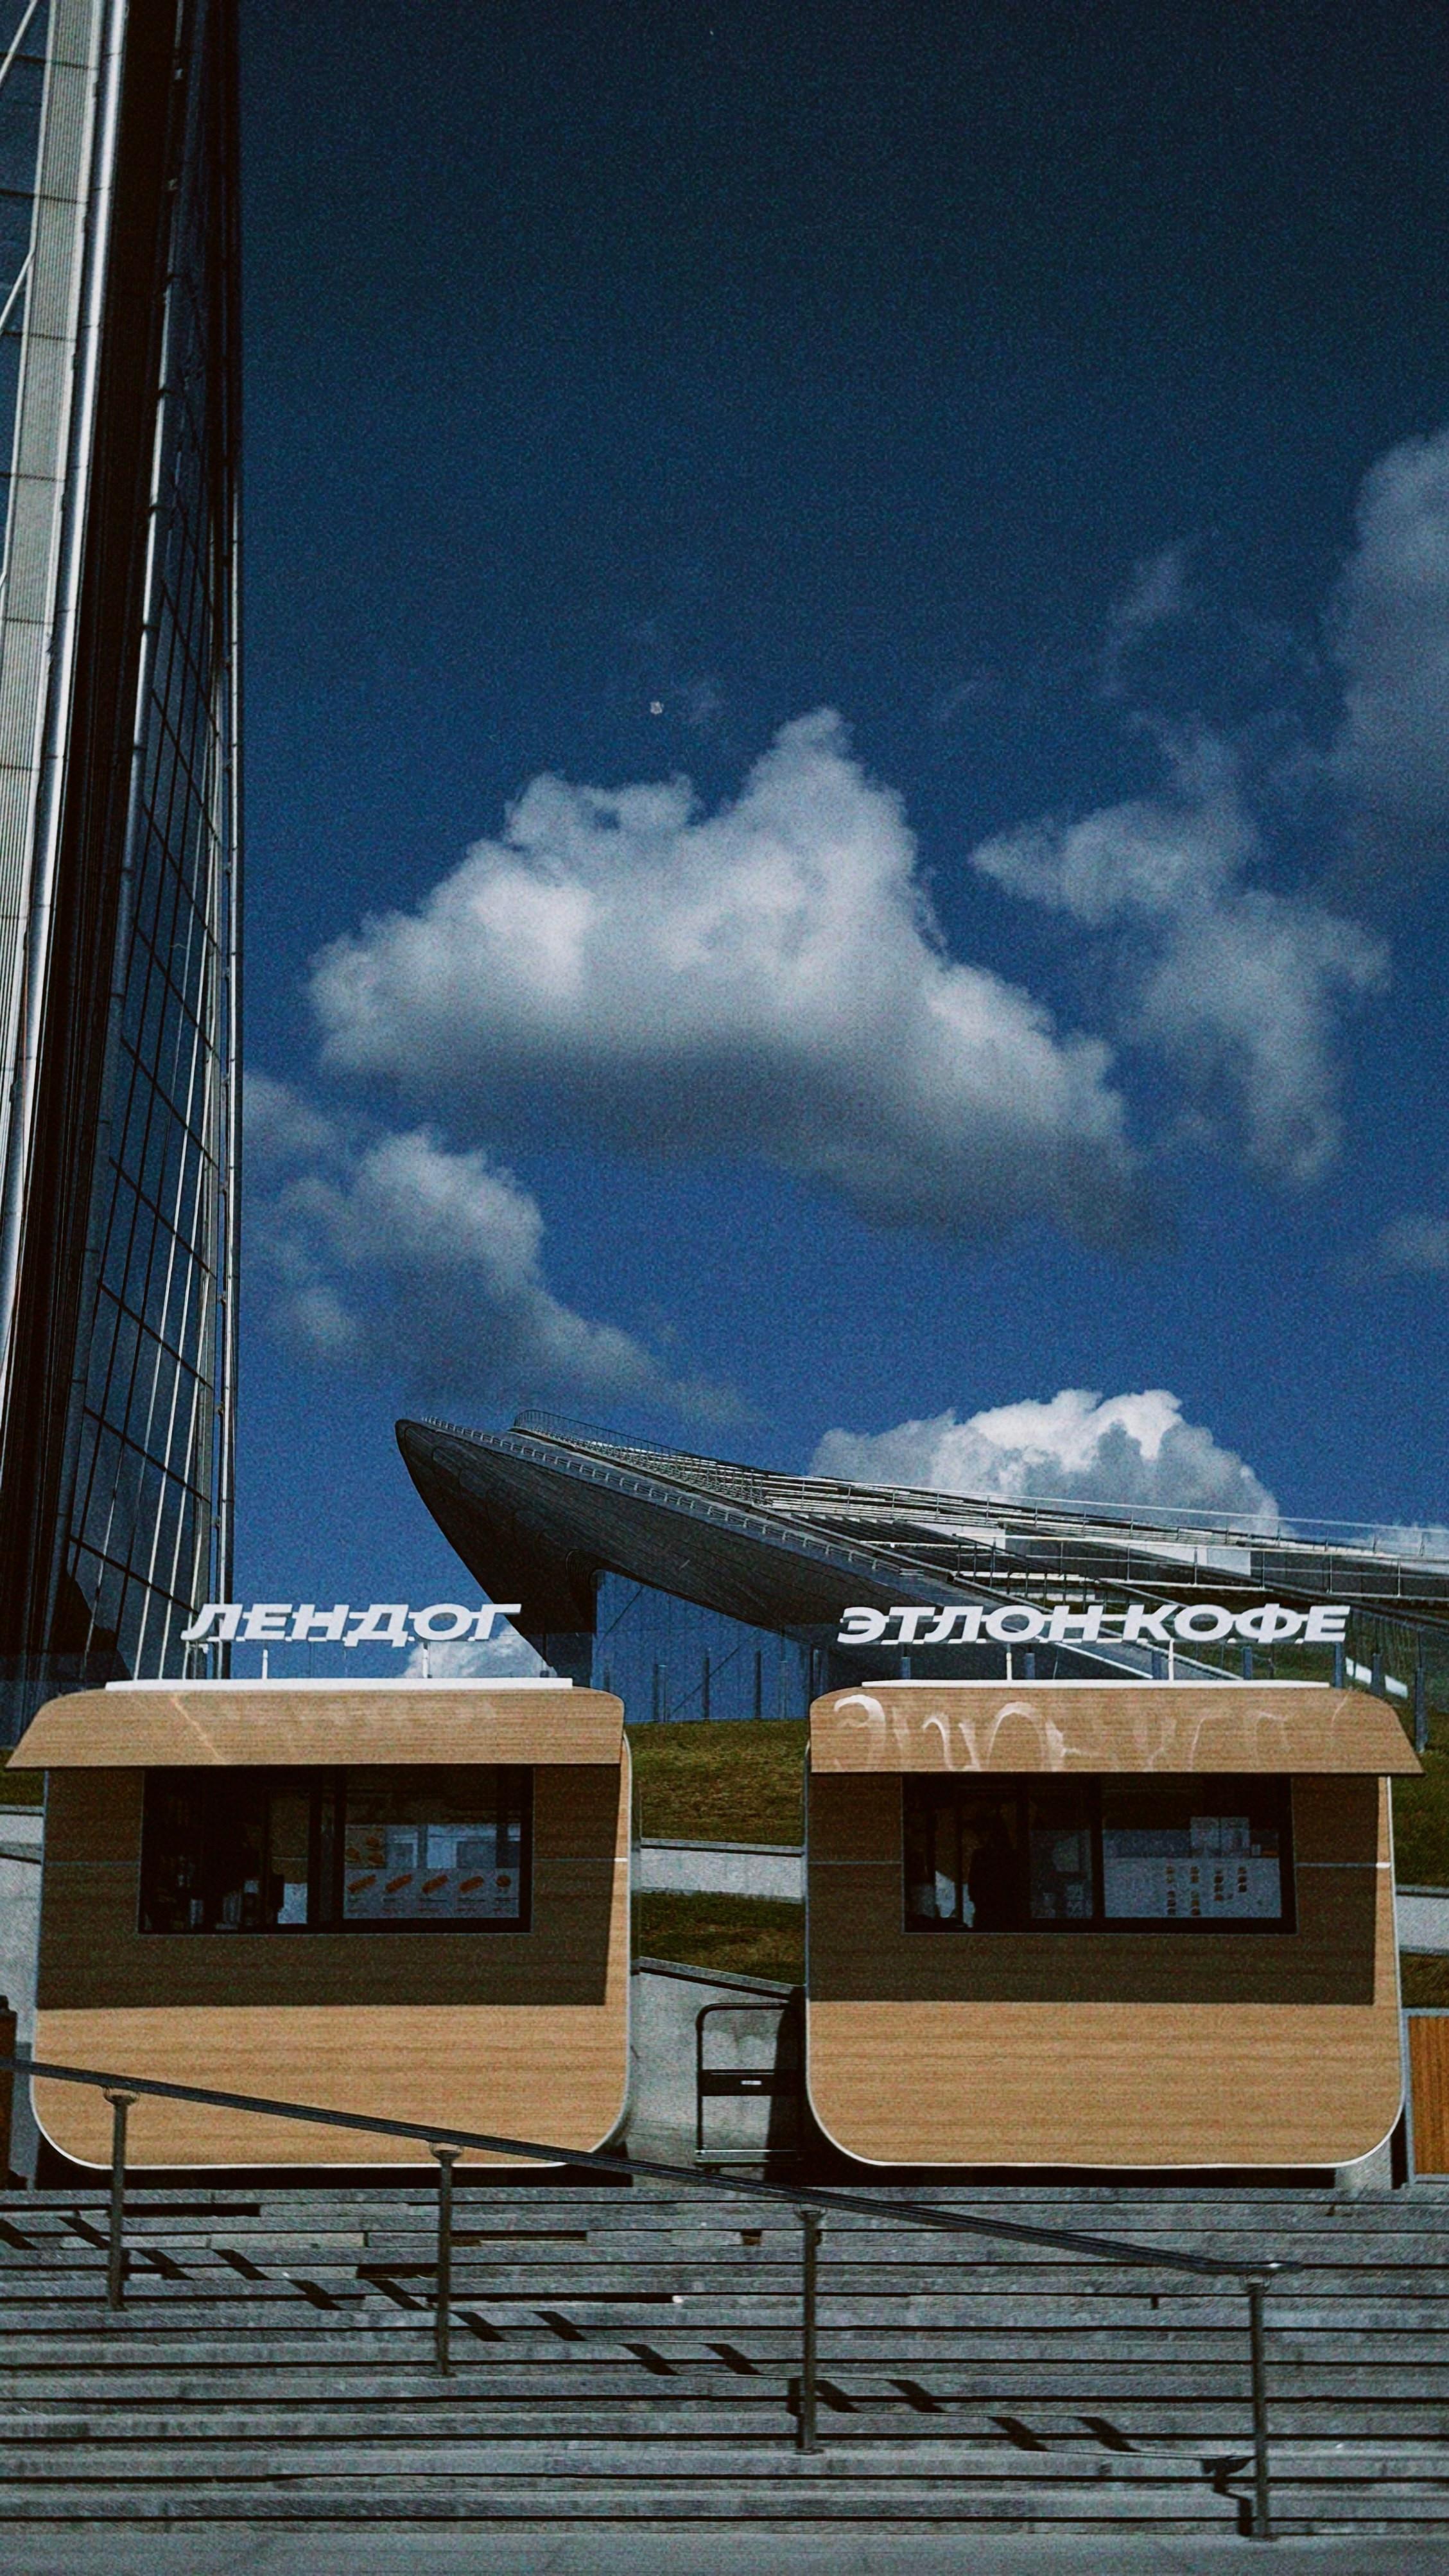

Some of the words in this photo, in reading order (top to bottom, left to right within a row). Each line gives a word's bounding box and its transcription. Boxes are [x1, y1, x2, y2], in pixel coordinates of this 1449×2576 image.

[180, 1603, 522, 1648] ЛЕНДОГ
[837, 1605, 1106, 1644] ЭТЛОН
[1122, 1603, 1351, 1644] КОФЕ
